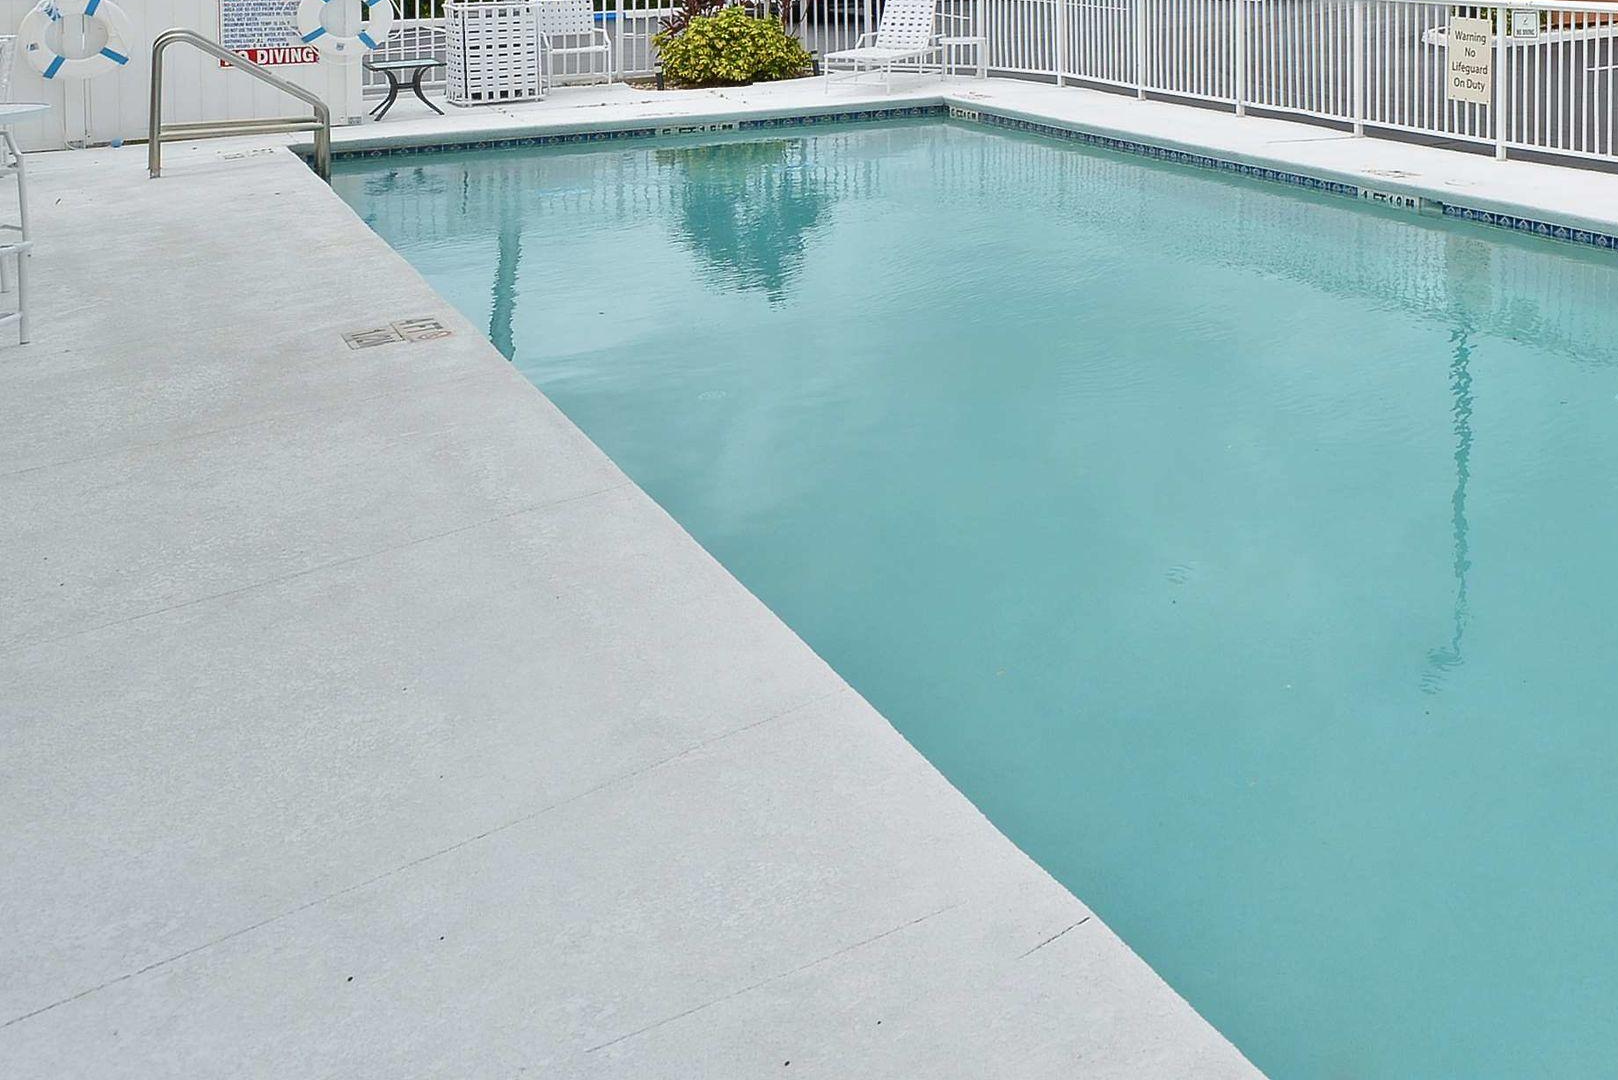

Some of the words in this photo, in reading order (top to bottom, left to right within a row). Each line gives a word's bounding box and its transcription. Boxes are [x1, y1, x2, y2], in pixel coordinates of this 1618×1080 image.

[1455, 30, 1487, 45] Warning
[256, 48, 315, 65] DIVING
[1464, 47, 1476, 58] No
[1452, 61, 1488, 75] Lifeguard
[1453, 77, 1466, 88] On
[1466, 78, 1486, 92] Duty
